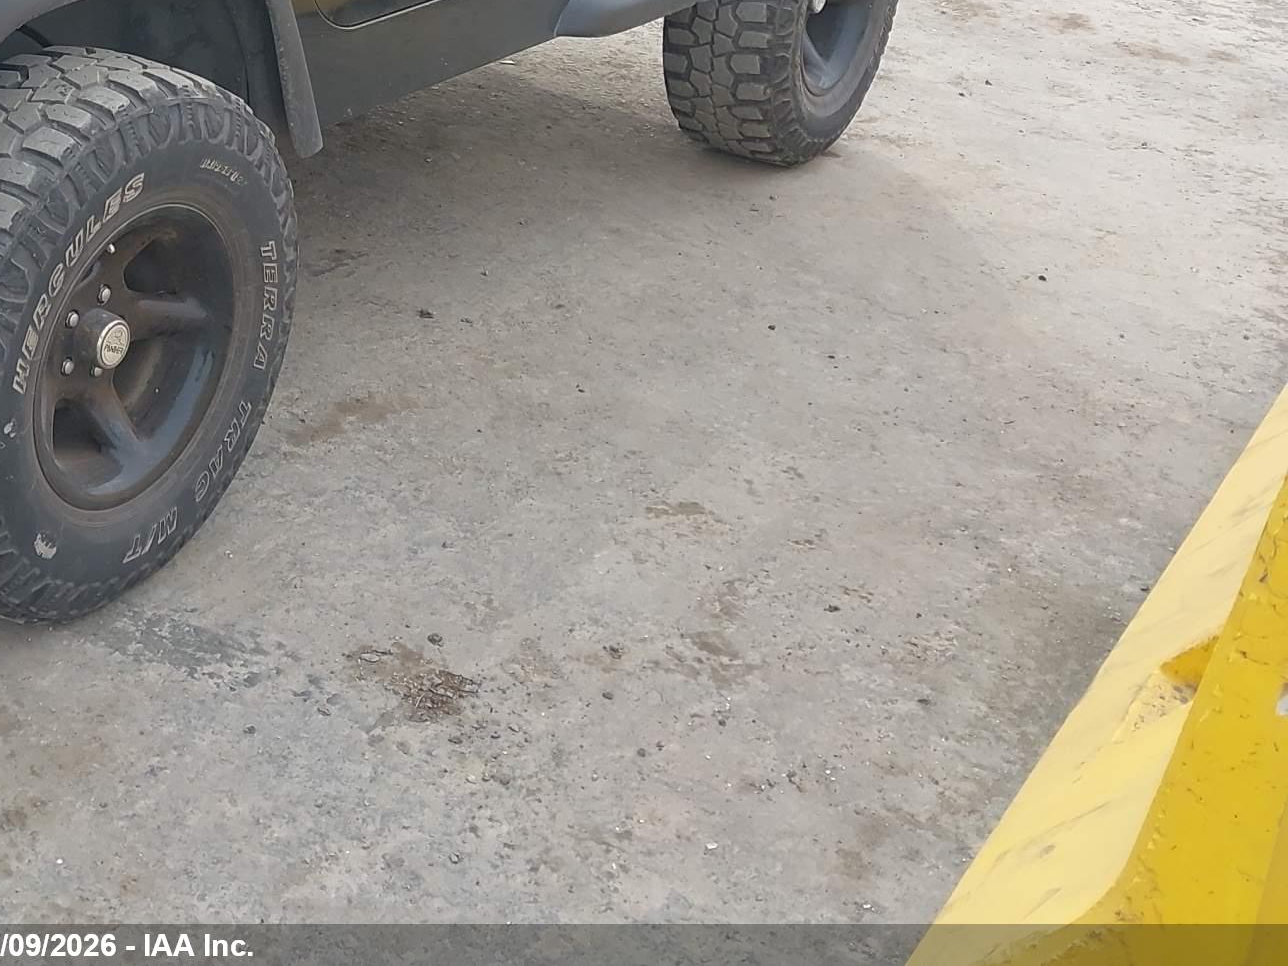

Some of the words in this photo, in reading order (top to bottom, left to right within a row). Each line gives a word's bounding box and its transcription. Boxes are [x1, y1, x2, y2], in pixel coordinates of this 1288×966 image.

[12, 172, 145, 395] HERCULES
[253, 240, 278, 370] TERRA
[194, 400, 252, 503] TRAC
